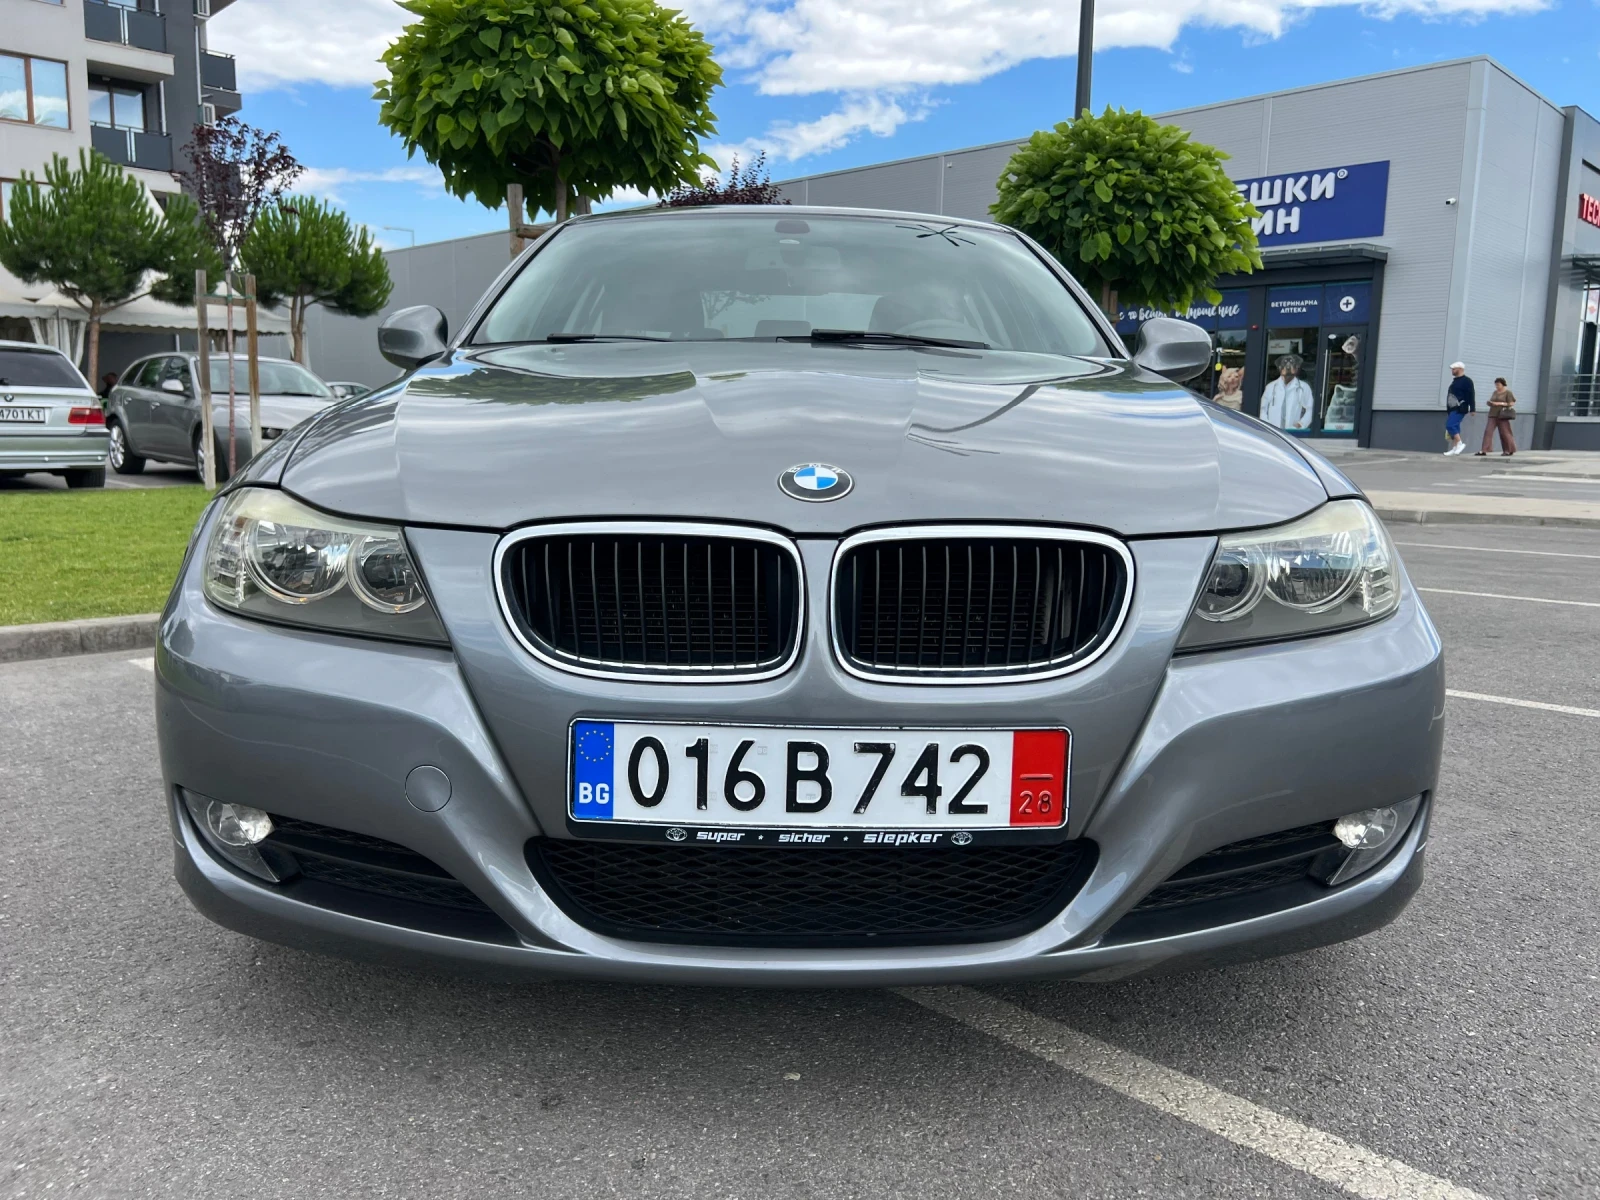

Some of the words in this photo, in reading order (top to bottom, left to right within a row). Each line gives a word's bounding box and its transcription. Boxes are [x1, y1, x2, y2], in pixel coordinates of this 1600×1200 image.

[1270, 300, 1318, 308] ВЕТЕРИНАРНА
[579, 782, 609, 804] BG
[1019, 790, 1052, 814] 28
[696, 831, 745, 841] super
[778, 832, 830, 843] sicher
[863, 832, 942, 846] siepker
